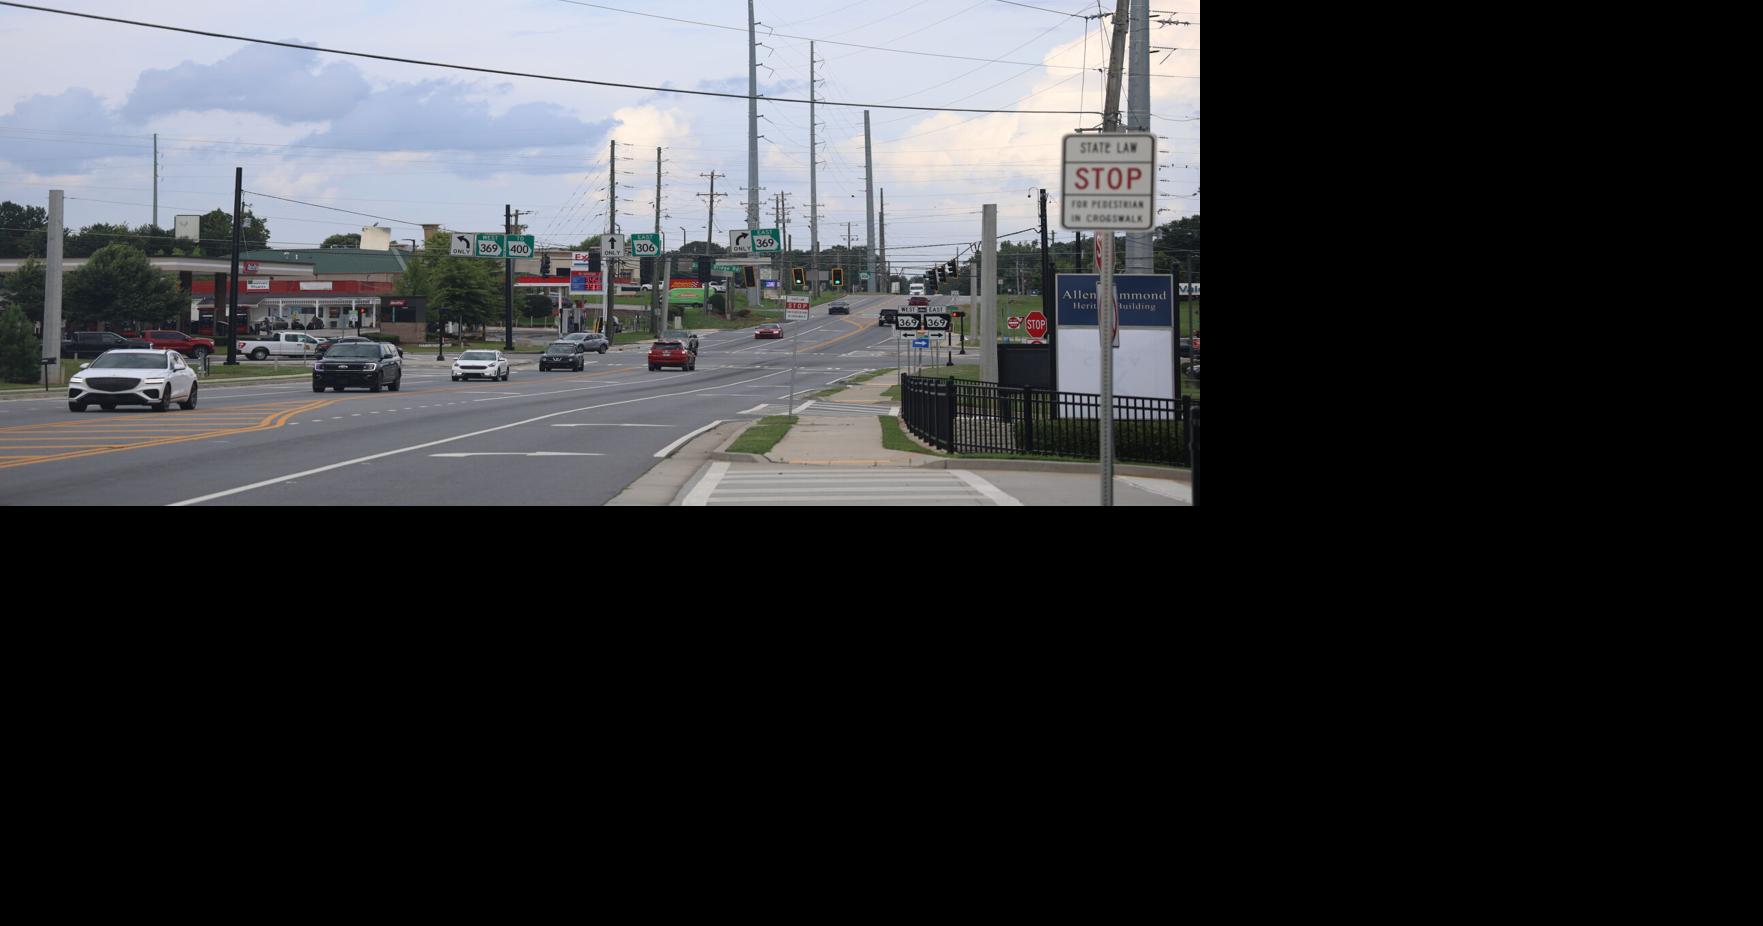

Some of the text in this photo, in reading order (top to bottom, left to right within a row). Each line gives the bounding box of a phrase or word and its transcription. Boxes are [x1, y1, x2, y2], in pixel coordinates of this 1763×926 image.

[1080, 142, 1138, 154] STATE LAW
[1074, 167, 1142, 190] STOP
[1071, 200, 1144, 209] FOR PEDESTRIAN
[1071, 214, 1081, 222] IN
[480, 243, 498, 253] 369
[636, 243, 655, 253] 306
[756, 238, 774, 248] 369
[510, 245, 529, 254] 400
[1063, 290, 1167, 300] Allen mmond
[1027, 320, 1046, 330] STOP
